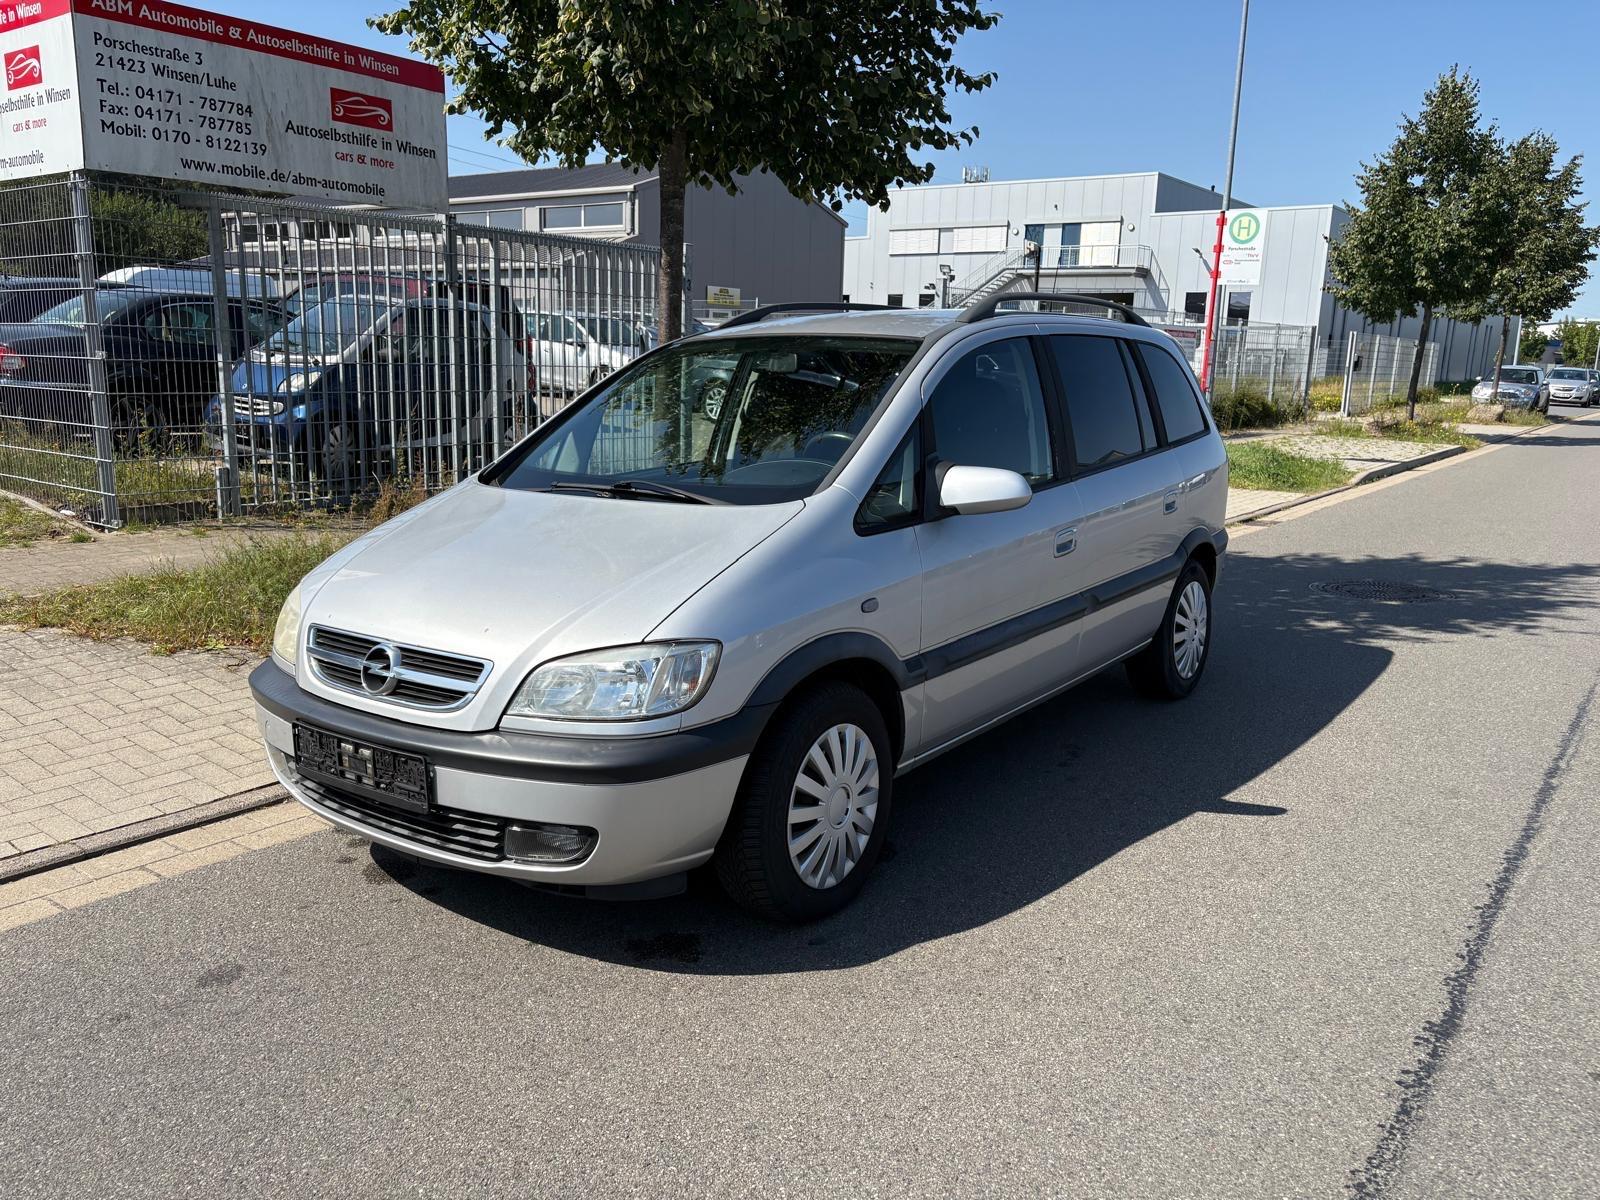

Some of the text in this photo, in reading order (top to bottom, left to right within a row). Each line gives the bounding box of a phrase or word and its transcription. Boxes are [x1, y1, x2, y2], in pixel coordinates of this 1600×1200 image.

[7, 7, 16, 22] in
[16, 2, 42, 20] Winsen
[91, 0, 400, 76] ABM Automobile & Autoselbsthilfe in Winsen
[93, 31, 203, 66] Porschestraße 3
[95, 53, 237, 91] 21423 Winsen/Luhe
[37, 91, 44, 106] in
[45, 88, 71, 104] Winsen
[97, 78, 130, 97] Tel.:
[135, 85, 182, 106] 04171
[199, 96, 253, 117] 787784
[12, 118, 47, 133] cars & more
[99, 99, 129, 117] Fax:
[134, 105, 181, 125] 04171
[199, 115, 252, 136] 787785
[100, 119, 147, 139] Mobil:
[152, 127, 191, 145] 0170
[205, 135, 268, 156] 8122139
[285, 120, 436, 160] Autoselbsthilfe in Winsen
[180, 158, 386, 197] www.mobile.de/abm-automobile
[335, 151, 395, 170] cars & more
